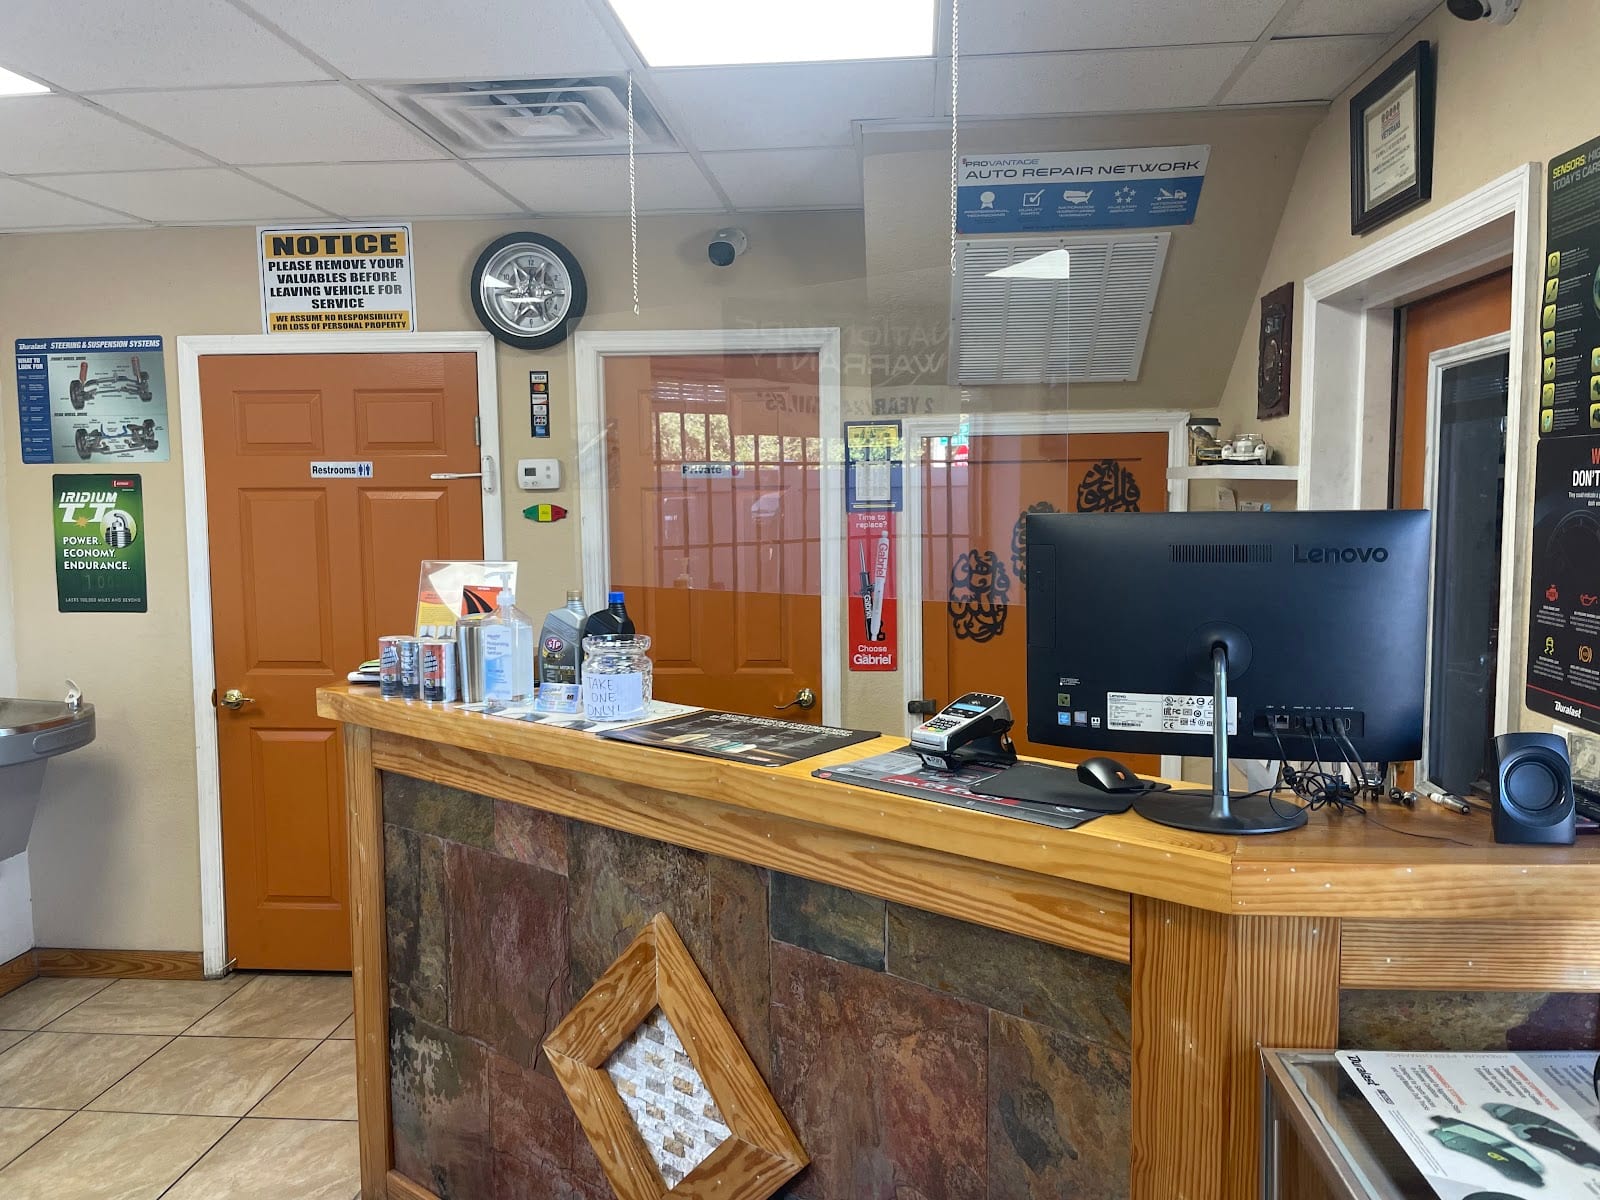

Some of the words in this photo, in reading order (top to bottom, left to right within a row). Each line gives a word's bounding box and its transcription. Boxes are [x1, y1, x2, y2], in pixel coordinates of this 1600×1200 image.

[966, 170, 1018, 180] AUTO
[1022, 166, 1093, 178] REPAIR
[1098, 160, 1200, 175] NETWORK
[272, 234, 398, 256] NOTICE
[268, 260, 312, 272] PLEASE
[316, 259, 366, 270] REMOVE
[368, 258, 404, 269] YOUR
[277, 272, 346, 284] VALUABLES
[350, 272, 397, 282] BEFORE
[270, 286, 320, 297] LEAVING
[324, 285, 375, 296] VEHICLE
[378, 284, 402, 294] FOR
[312, 298, 364, 309] SERVICE
[338, 313, 403, 321] RESPONSIBILITY
[322, 322, 364, 330] PERSONAL
[365, 321, 406, 329] PROPERTY
[50, 341, 81, 350] STEERING
[88, 340, 128, 349] SUSPENSION
[129, 340, 160, 348] SYSTEMS
[312, 466, 356, 474] Restrooms
[682, 465, 722, 474] Private
[1572, 470, 1600, 487] DON'T
[60, 492, 118, 503] IRIDIUM
[856, 521, 888, 529] replace?
[63, 536, 102, 545] POWER.
[63, 549, 116, 558] ECONOMY.
[1292, 544, 1389, 563] Lenovo
[64, 561, 131, 570] ENDURANCE.
[876, 543, 888, 578] Gabriel
[548, 639, 561, 650] STP
[853, 654, 892, 665] Gabriel
[586, 677, 614, 690] TAKE
[592, 693, 617, 703] ONE
[587, 704, 620, 716] ONLY!
[1554, 700, 1581, 718] Duralast
[1346, 1055, 1380, 1086] Duralast
